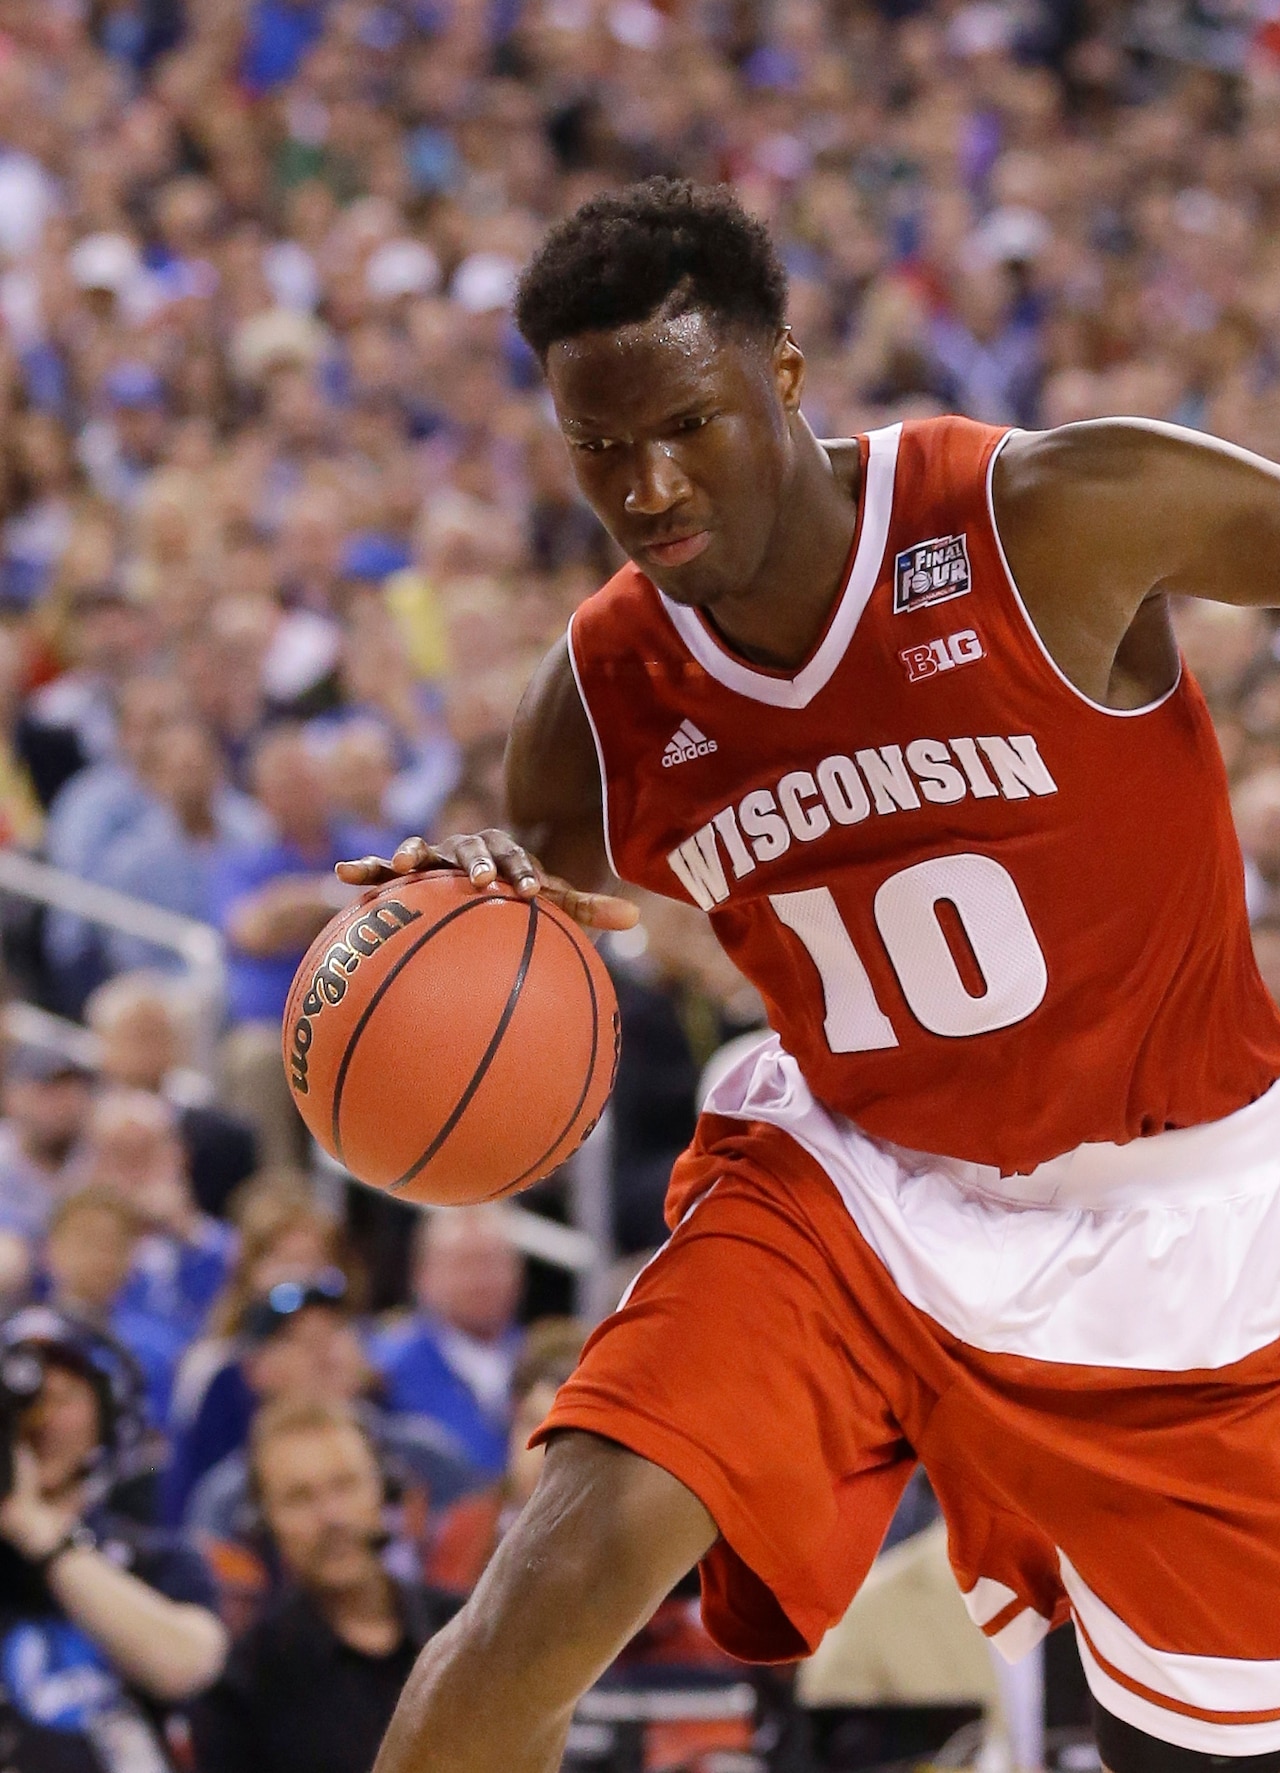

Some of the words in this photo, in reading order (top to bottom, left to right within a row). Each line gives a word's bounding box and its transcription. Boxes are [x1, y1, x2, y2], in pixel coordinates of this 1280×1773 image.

[902, 558, 969, 602] FOUR
[915, 541, 962, 572] FINAL
[661, 739, 718, 768] adidas
[667, 735, 1058, 912] WISCONSIN
[291, 898, 423, 1096] Wilson
[768, 853, 1049, 1054] 10
